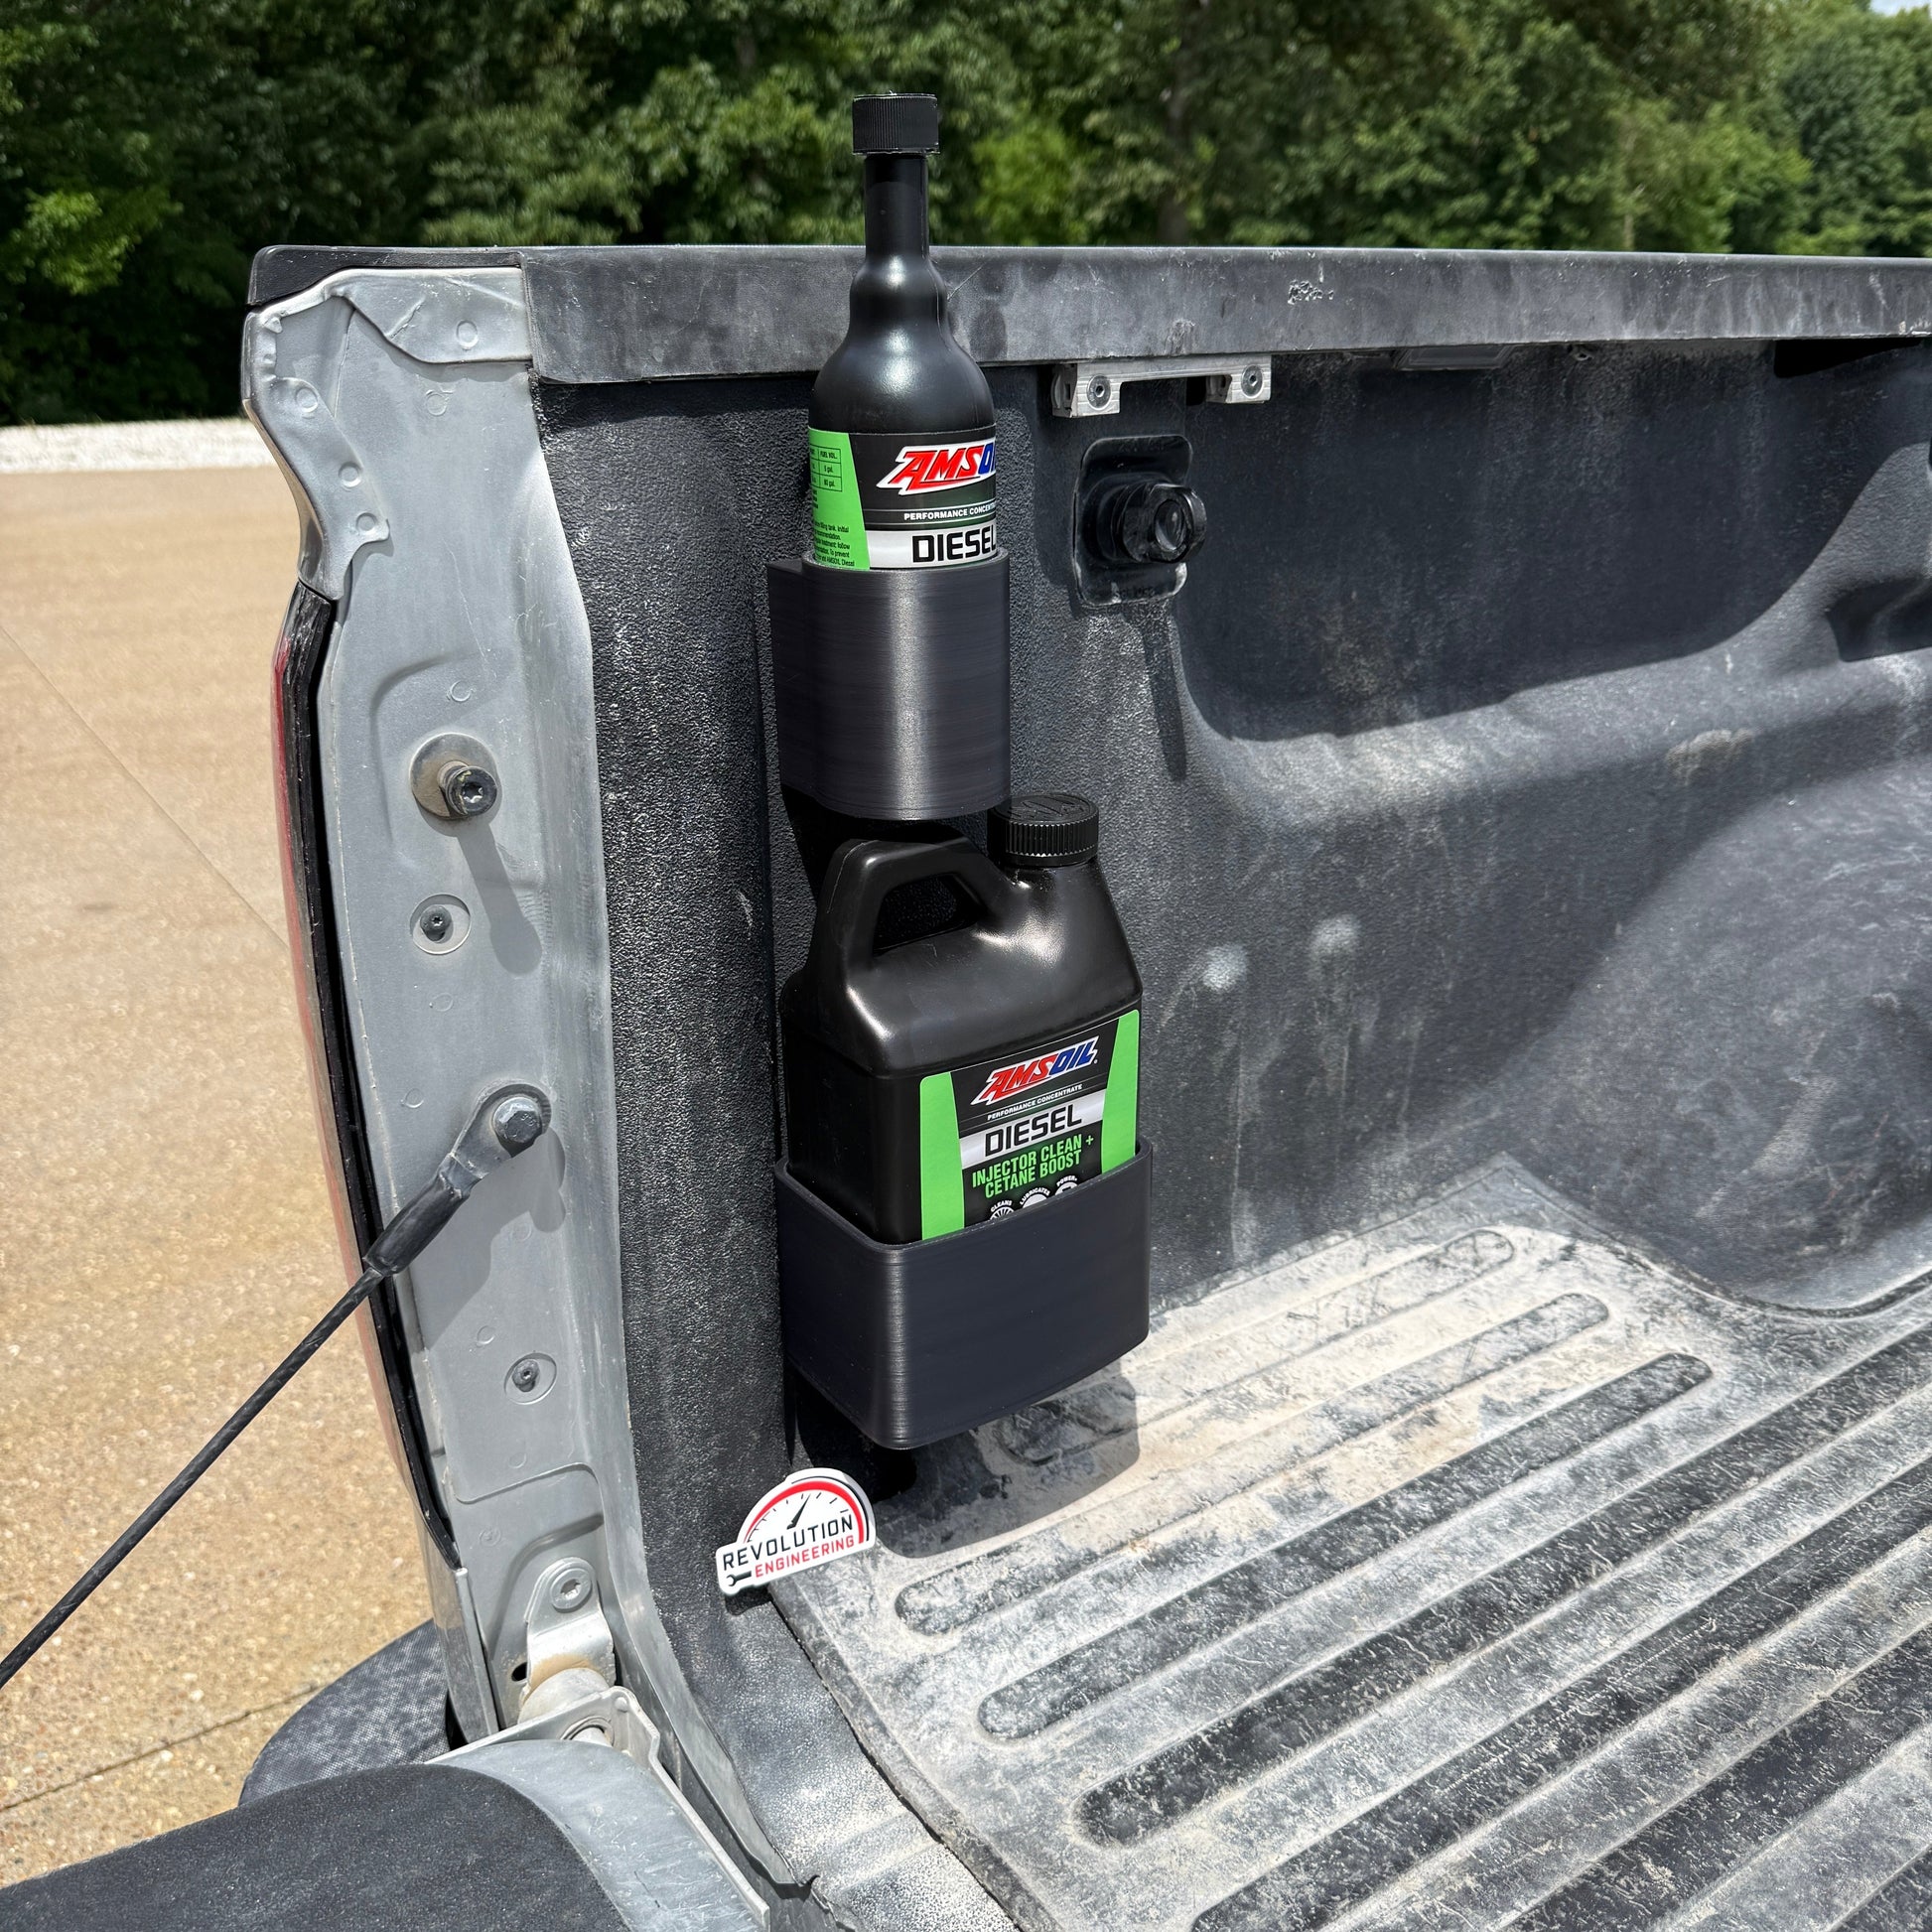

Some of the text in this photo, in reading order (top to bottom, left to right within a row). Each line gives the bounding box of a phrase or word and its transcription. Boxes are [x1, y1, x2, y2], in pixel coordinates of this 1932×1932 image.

[904, 508, 968, 521] PERFORMANCE
[912, 524, 996, 563] DIESEL
[972, 1036, 1098, 1104] AMSOIL
[987, 1083, 1083, 1120] PERFORMANCE CONCENTRATE
[985, 1104, 1082, 1158] DIESEL
[972, 1152, 1037, 1188] INJECTOR
[1040, 1134, 1082, 1162] CLEAN
[985, 1150, 1081, 1198] CETANE BOOST
[991, 1199, 1013, 1212] CLEANS
[1020, 1187, 1050, 1205] LUBRICATES
[723, 1514, 853, 1571] REVOLUTION
[755, 1535, 855, 1578] ENGINEERING
